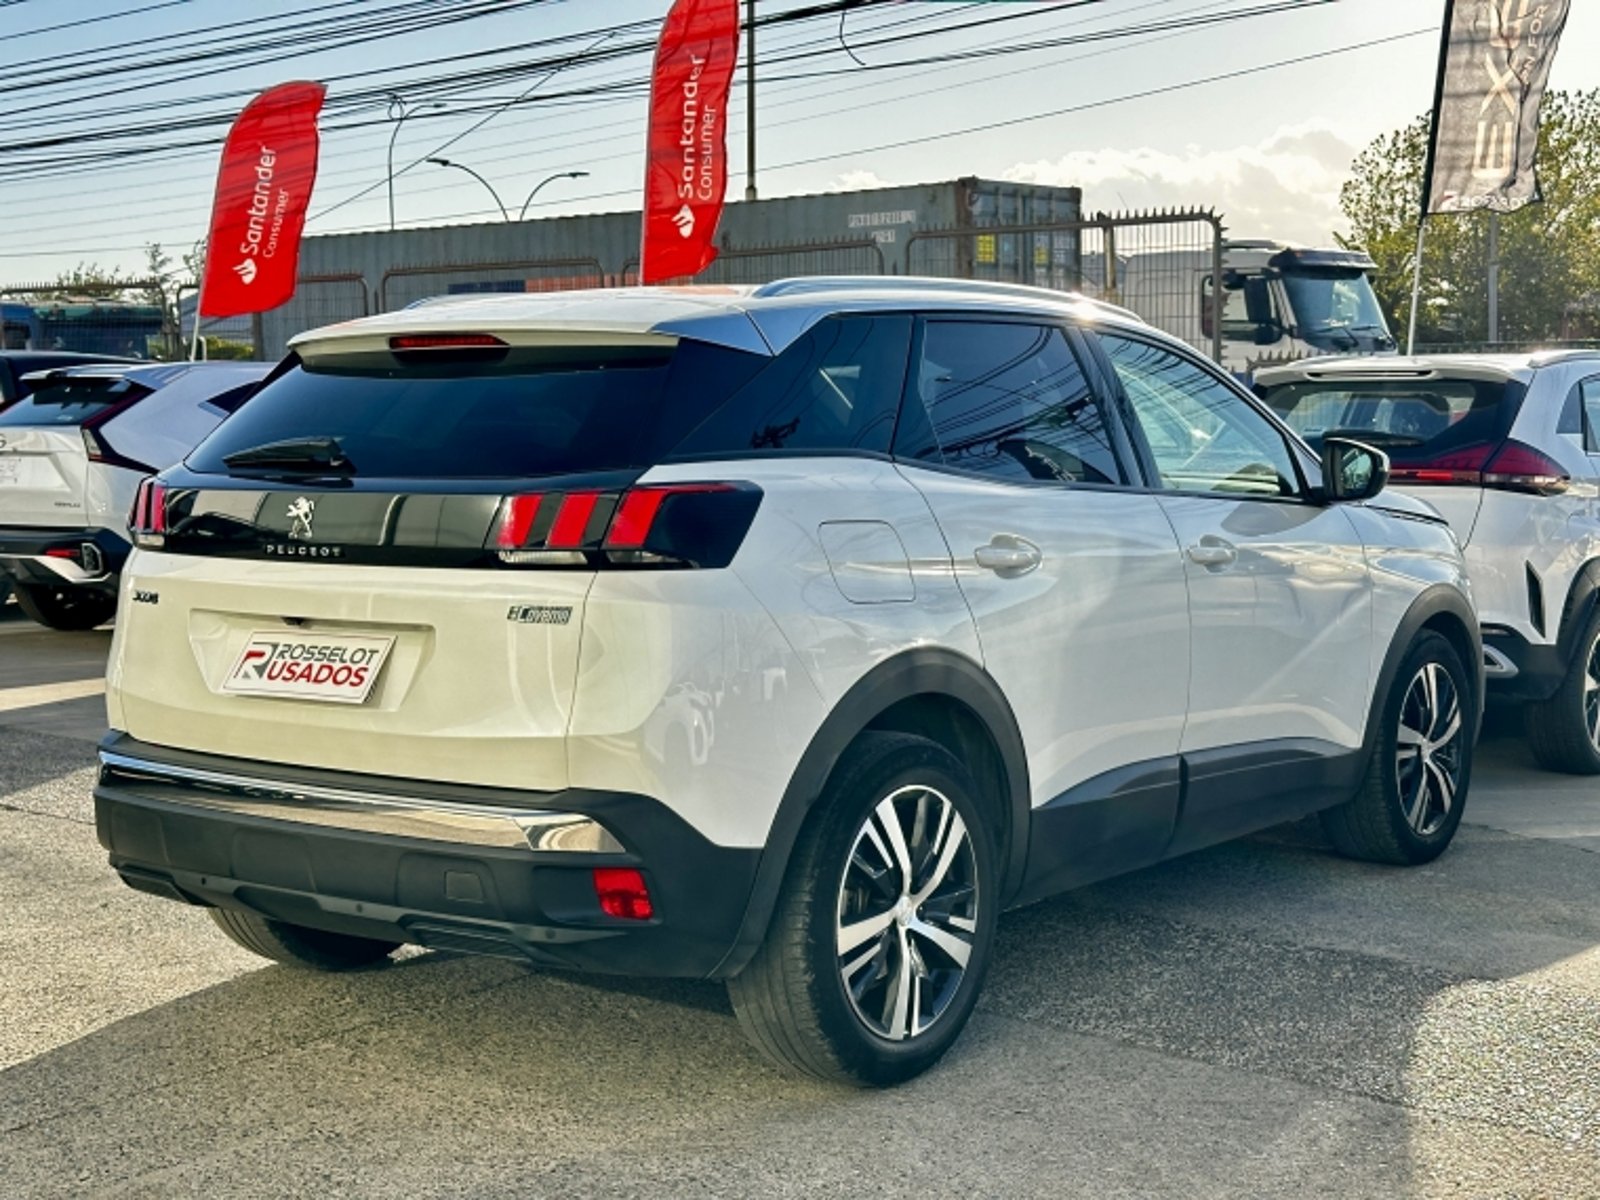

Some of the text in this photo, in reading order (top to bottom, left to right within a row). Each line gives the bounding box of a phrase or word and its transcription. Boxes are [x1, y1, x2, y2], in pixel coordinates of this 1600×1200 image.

[1528, 4, 1549, 48] FOR
[679, 53, 705, 199] Santander
[697, 104, 717, 201] Consumer
[240, 145, 277, 256] Santander
[262, 188, 290, 259] Consumer
[266, 544, 341, 557] PEUGEOT
[266, 661, 369, 687] USADOS
[275, 643, 380, 665] ROSSELOT
